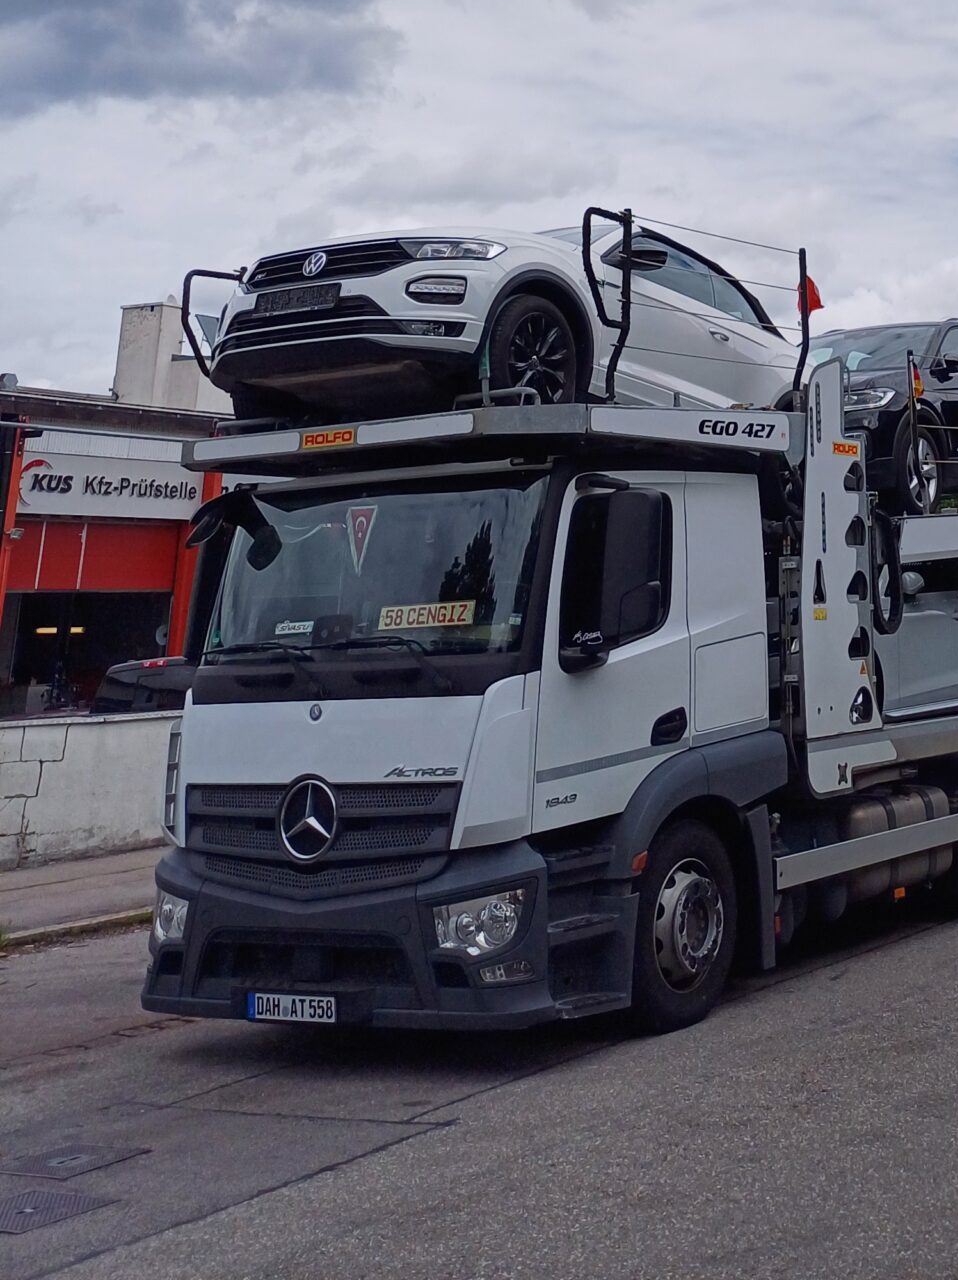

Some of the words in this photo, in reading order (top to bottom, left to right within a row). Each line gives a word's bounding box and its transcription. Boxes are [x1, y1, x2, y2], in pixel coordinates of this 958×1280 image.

[304, 430, 353, 446] ROLFO
[698, 419, 738, 436] EGO
[741, 422, 776, 439] 427
[31, 473, 74, 494] KÜS
[83, 475, 198, 500] Kfz-Prüfstelle
[384, 608, 404, 627] 58
[256, 996, 281, 1017] DAH
